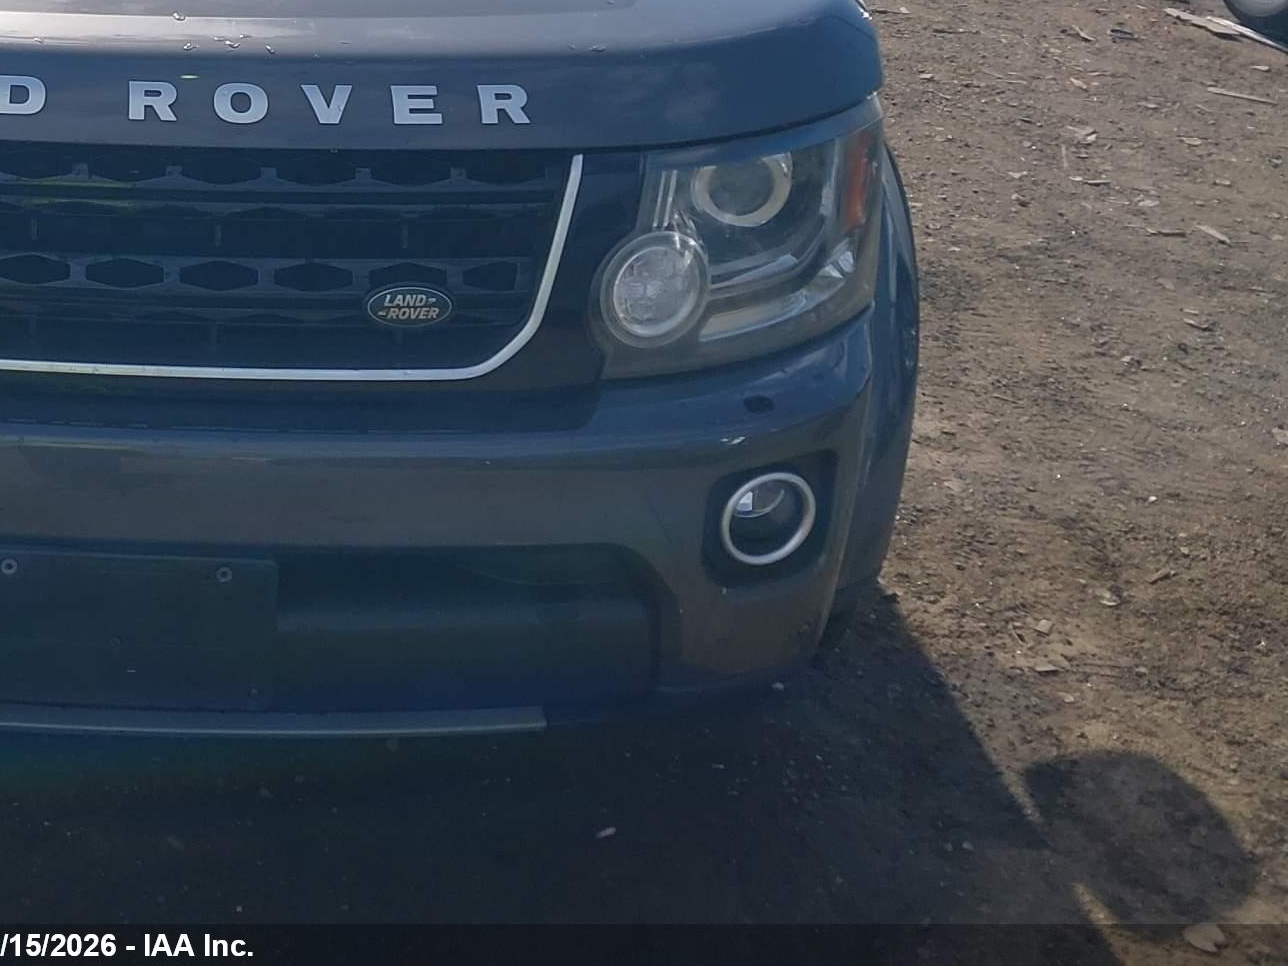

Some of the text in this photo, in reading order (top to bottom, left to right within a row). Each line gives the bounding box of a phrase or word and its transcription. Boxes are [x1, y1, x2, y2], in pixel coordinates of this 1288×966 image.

[127, 81, 531, 125] ROVER
[383, 294, 427, 307] LAND
[386, 307, 439, 320] ROVER
